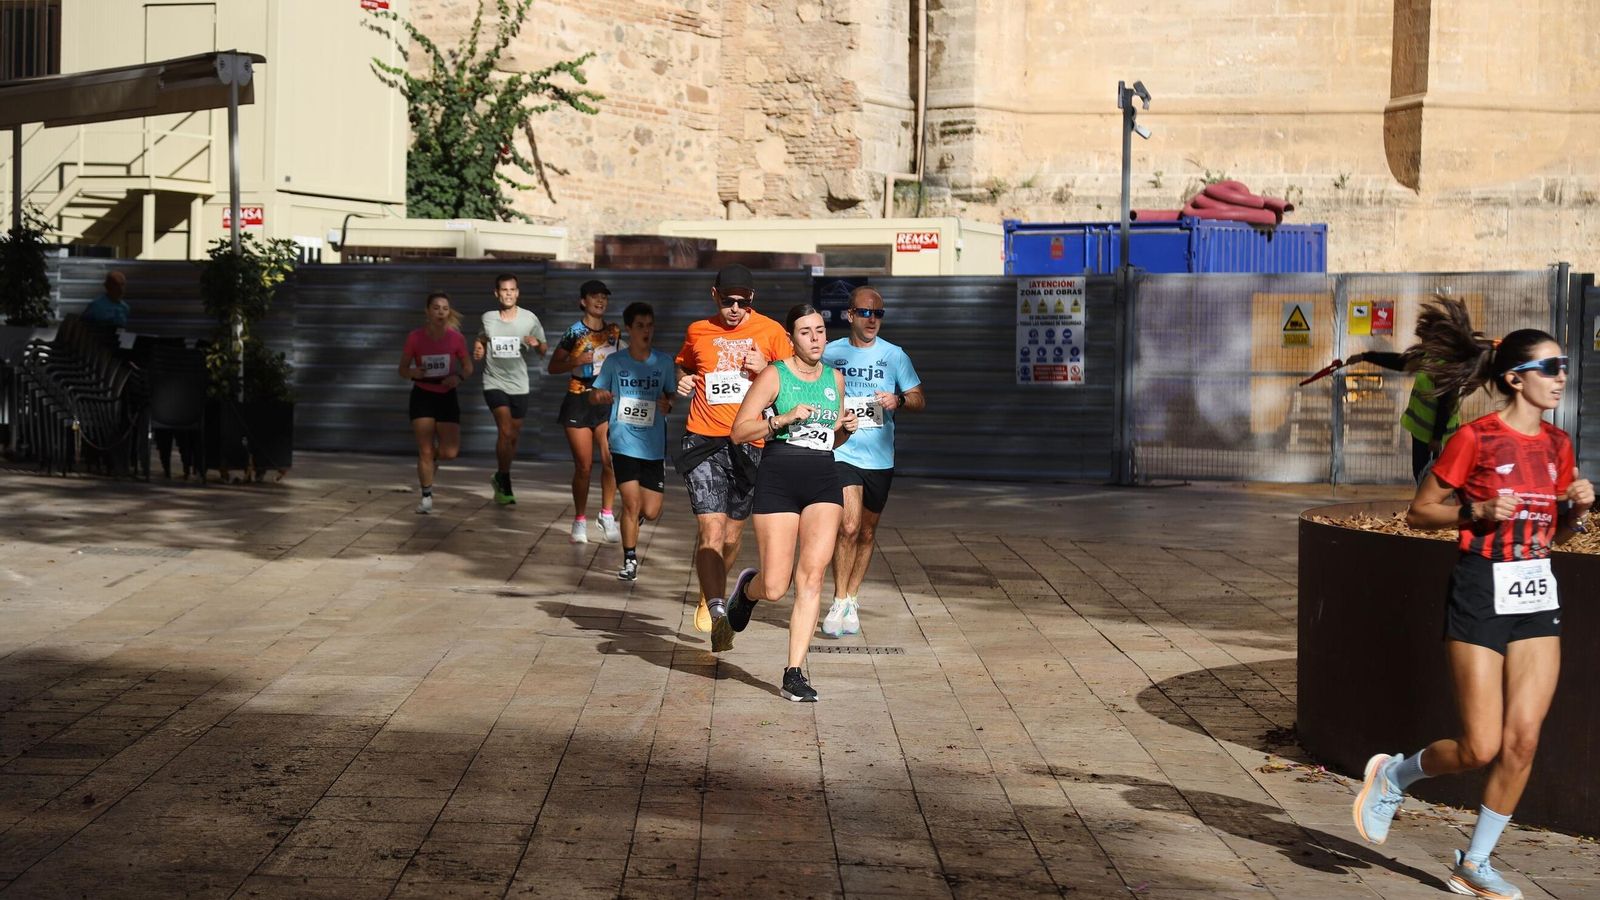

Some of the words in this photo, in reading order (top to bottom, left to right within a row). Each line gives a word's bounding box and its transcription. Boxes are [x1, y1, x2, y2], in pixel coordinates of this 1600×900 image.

[223, 208, 263, 219] RMSA
[897, 232, 939, 244] REMSA
[1029, 279, 1076, 288] ¡ATENCIÓN!
[619, 376, 659, 390] nerja
[712, 383, 741, 395] 526
[624, 407, 648, 418] 925
[809, 403, 839, 421] ijas
[1509, 578, 1548, 598] 445
